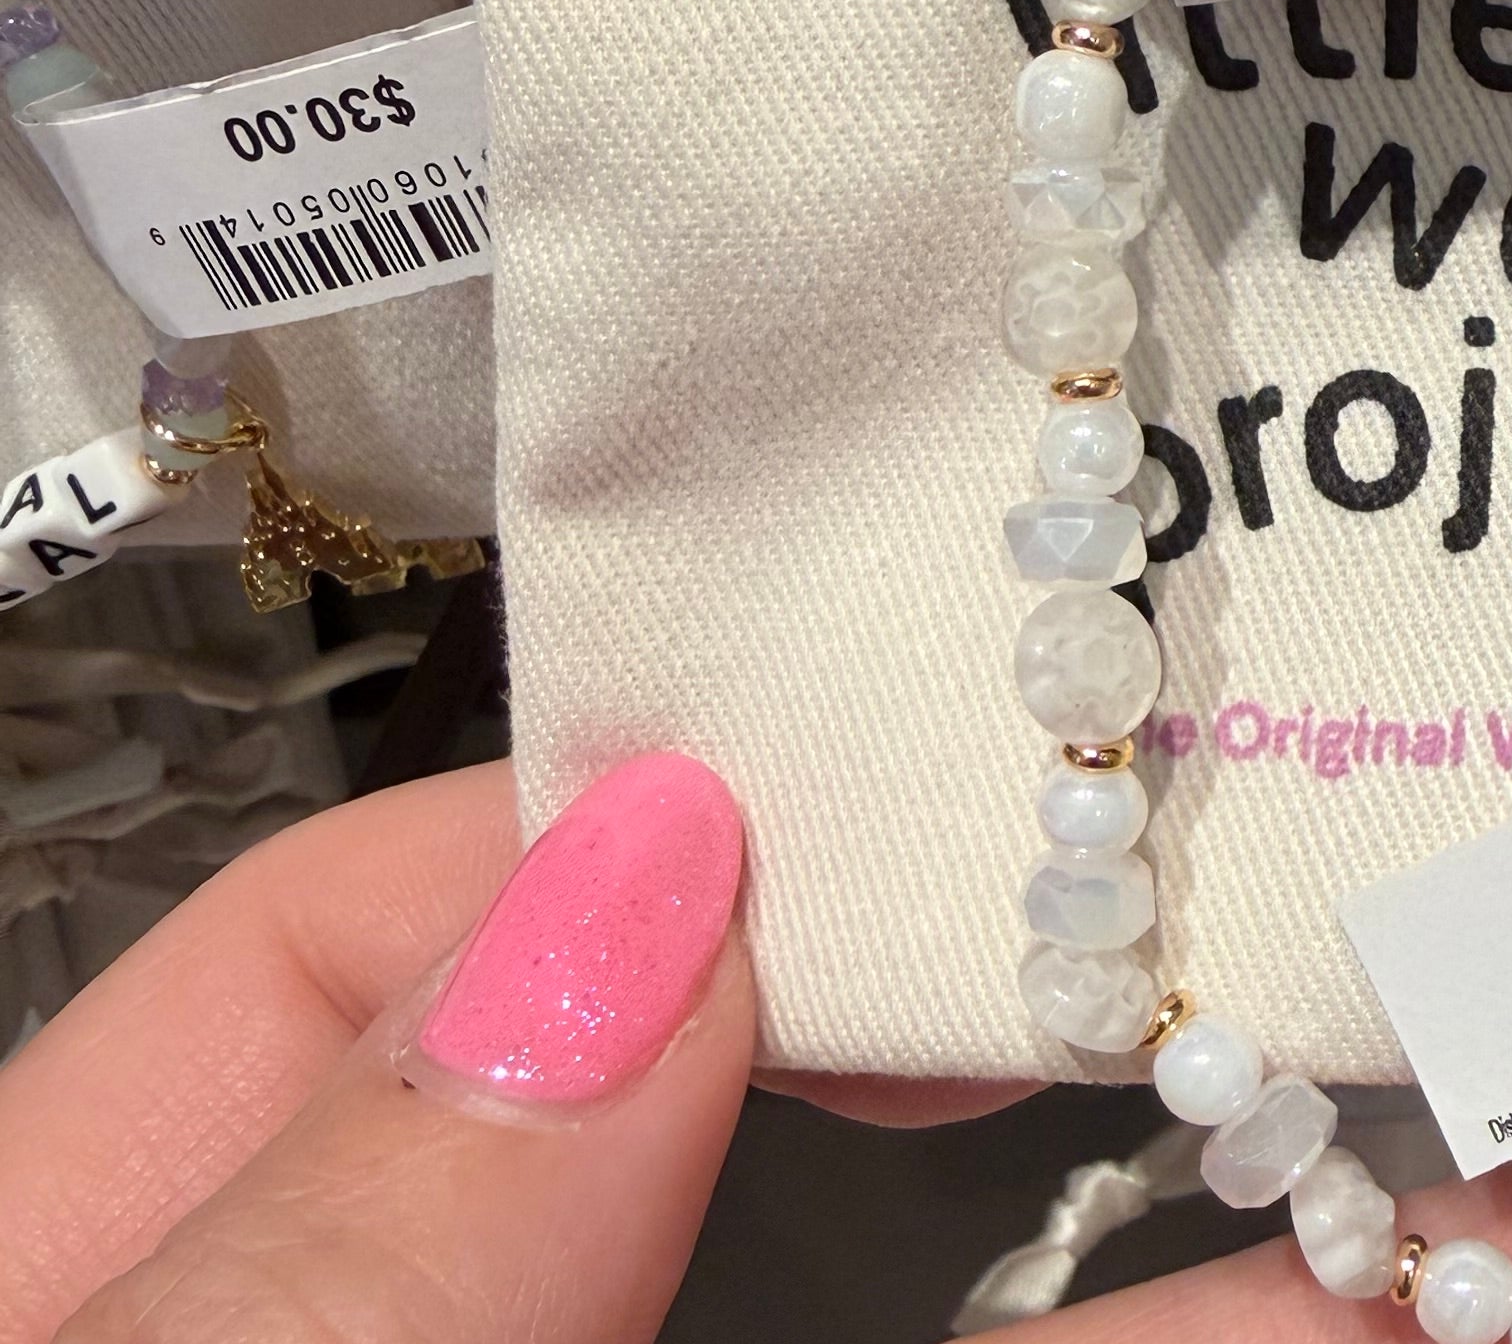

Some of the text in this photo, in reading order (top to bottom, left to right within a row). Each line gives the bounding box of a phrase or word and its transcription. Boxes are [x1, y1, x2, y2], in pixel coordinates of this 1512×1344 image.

[223, 74, 418, 162] $30.00
[150, 226, 167, 246] 9
[1214, 699, 1466, 779] Original
